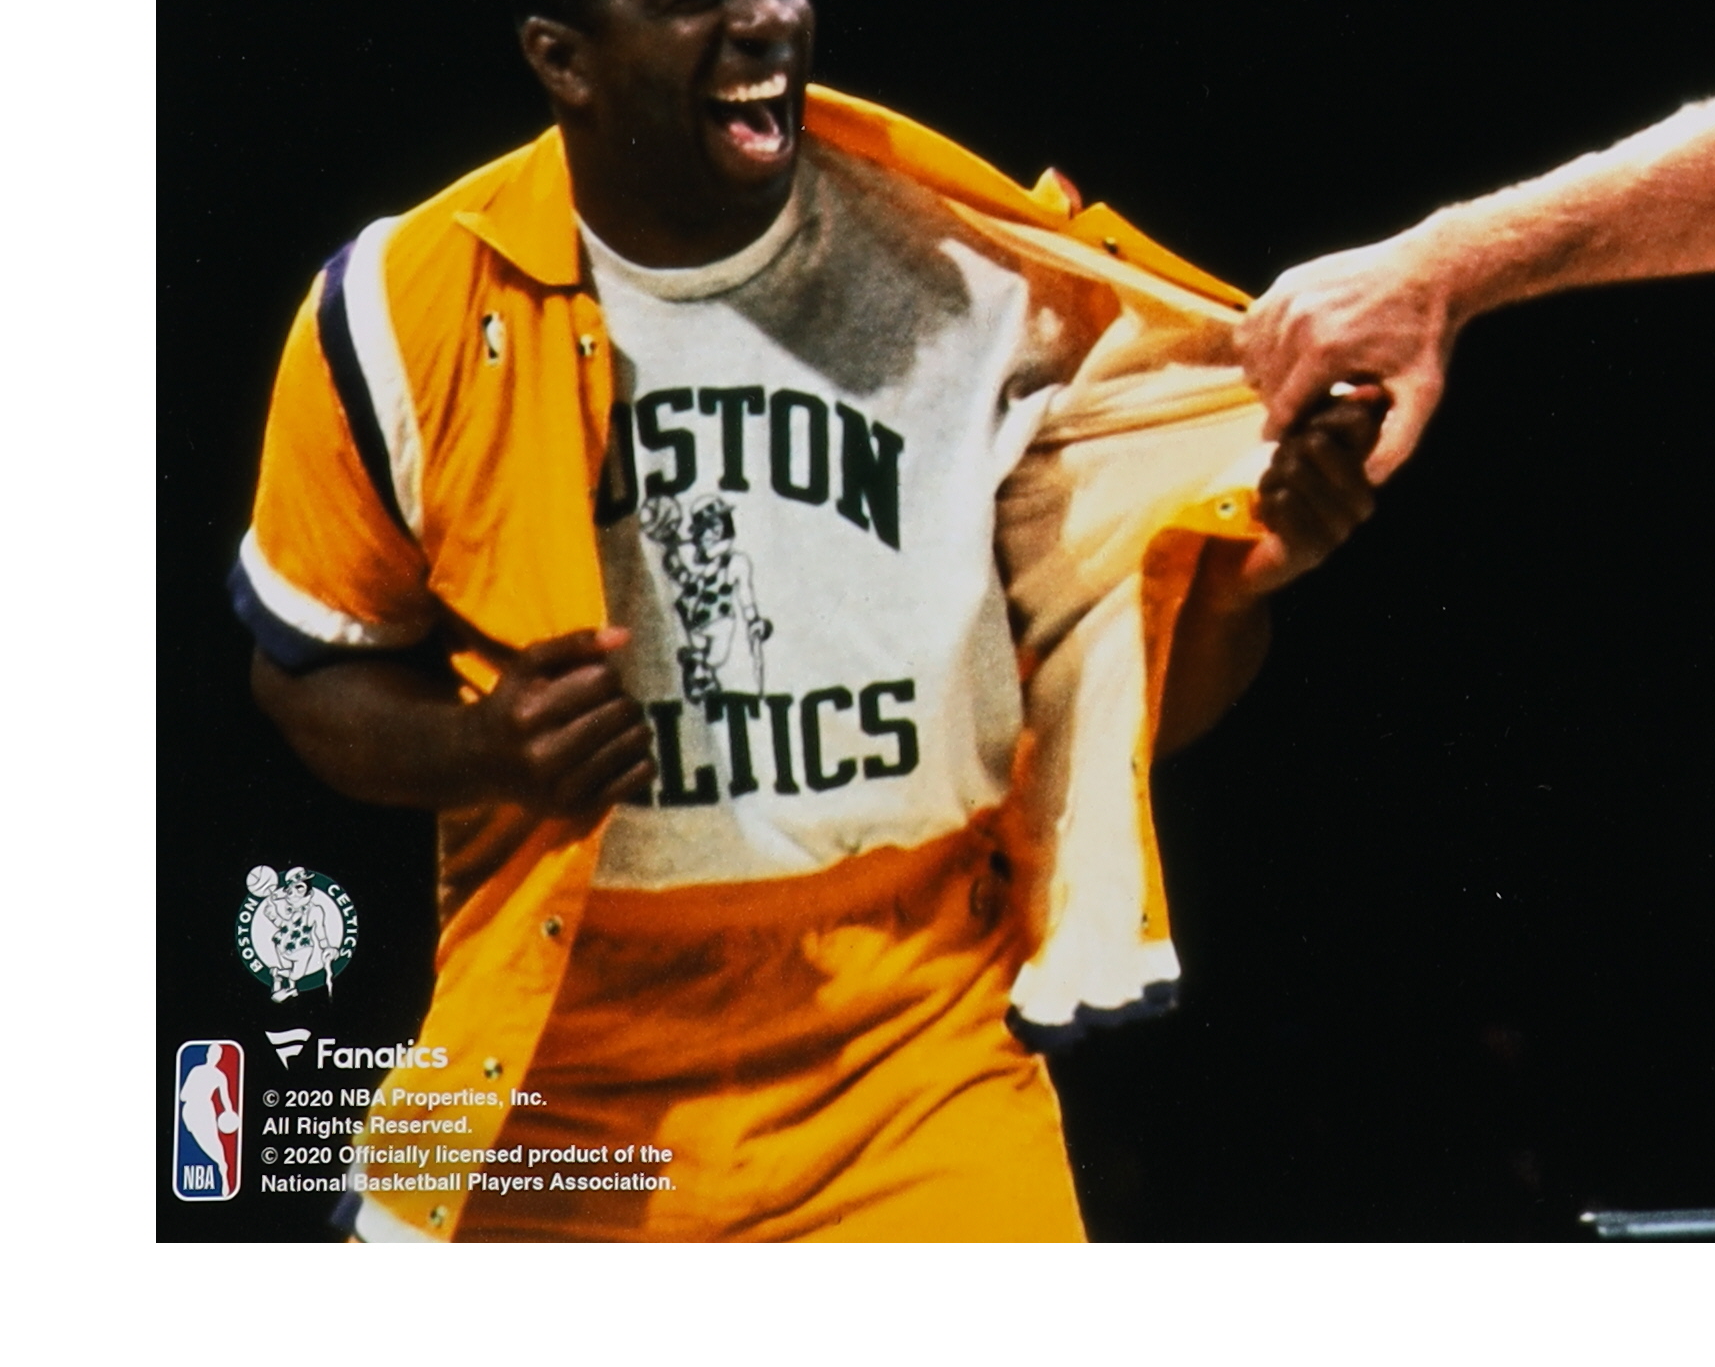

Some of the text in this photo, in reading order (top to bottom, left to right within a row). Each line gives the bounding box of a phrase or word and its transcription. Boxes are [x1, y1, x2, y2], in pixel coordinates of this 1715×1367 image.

[328, 884, 357, 958] CELTICS
[238, 897, 263, 973] BOSTON
[317, 1038, 448, 1069] Fanatics
[285, 1090, 333, 1107] 2020
[340, 1089, 386, 1107] NBA
[391, 1088, 503, 1110] Properties,
[510, 1090, 547, 1107] Inc.
[262, 1116, 472, 1139] All Rights Reserved.
[284, 1147, 332, 1164] 2020
[339, 1146, 430, 1167] Officially
[436, 1145, 522, 1163] licensed
[529, 1145, 608, 1167] product
[614, 1145, 634, 1163] of
[640, 1145, 673, 1163] the
[183, 1165, 215, 1190] NBA
[261, 1173, 676, 1195] National Basketball Players Association.
